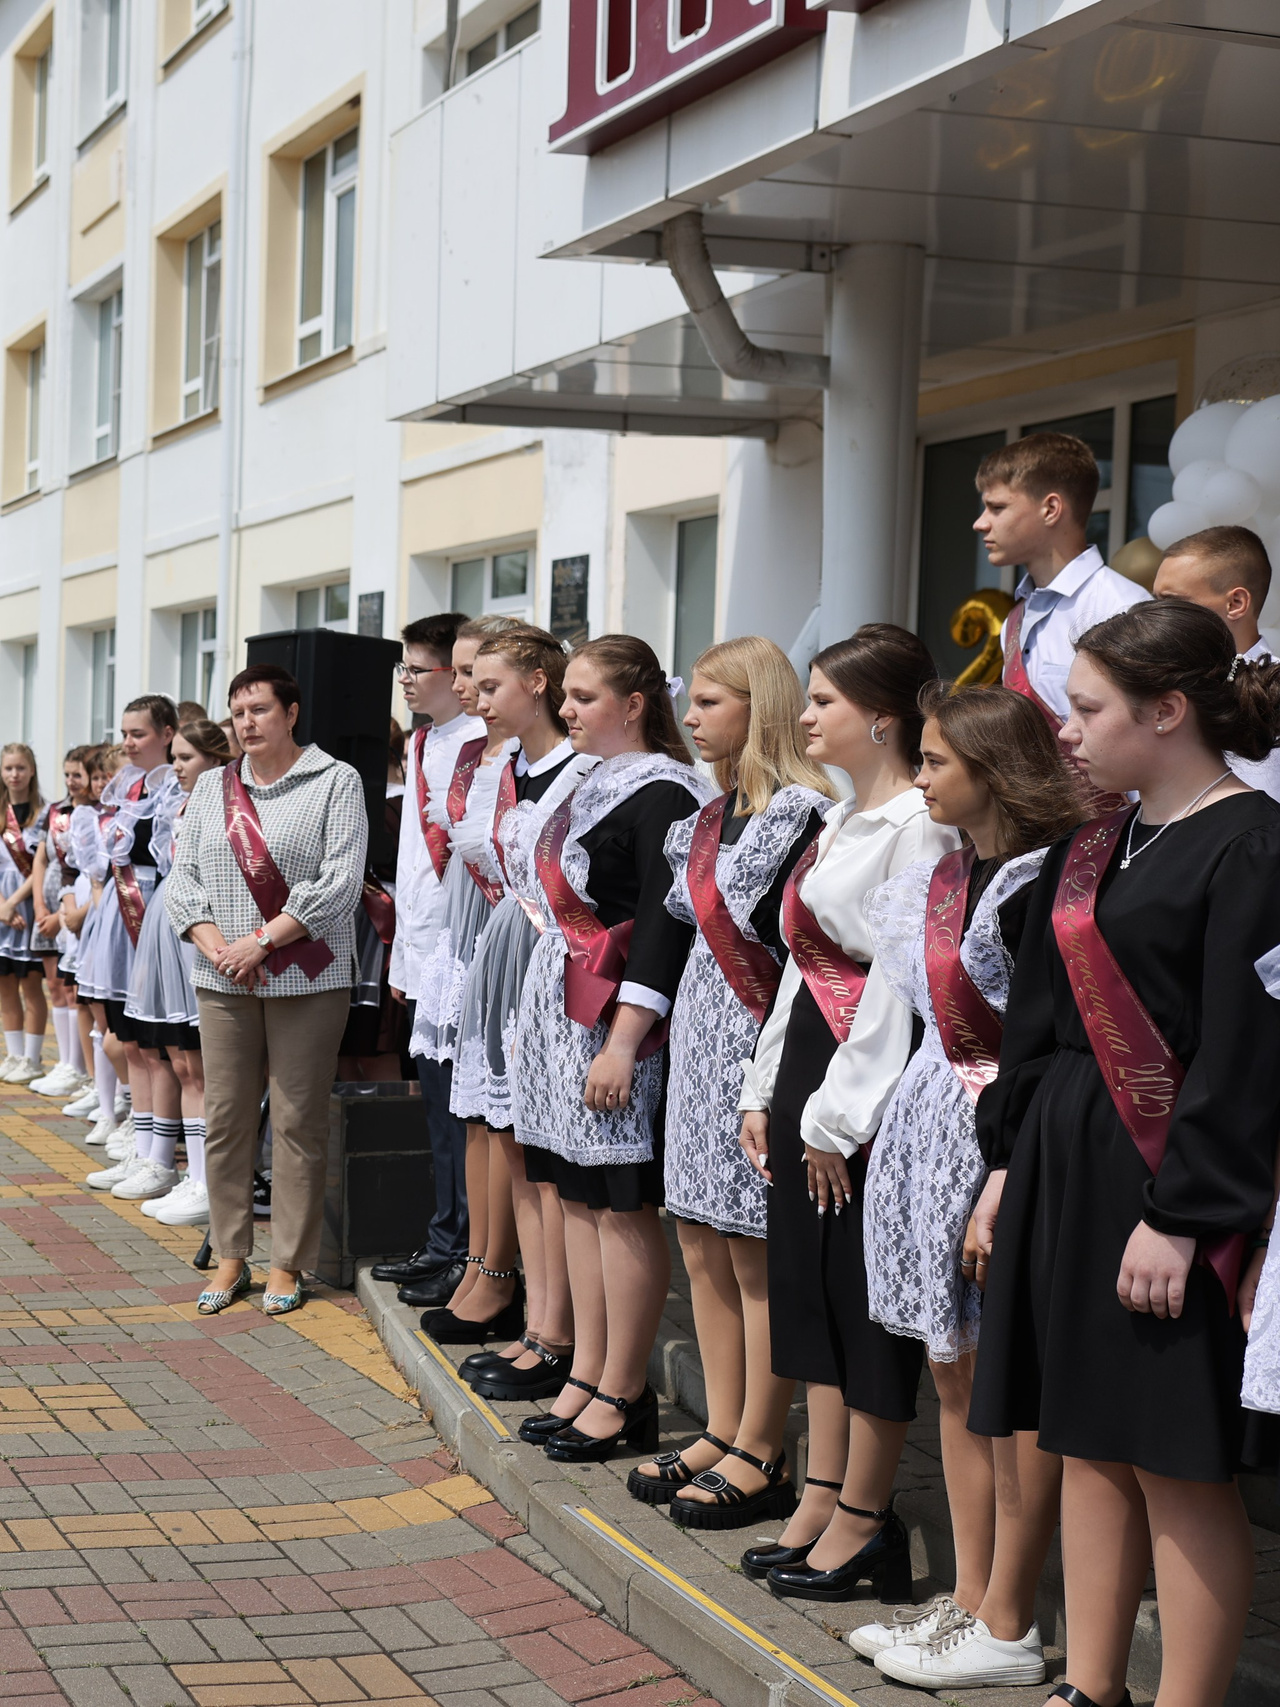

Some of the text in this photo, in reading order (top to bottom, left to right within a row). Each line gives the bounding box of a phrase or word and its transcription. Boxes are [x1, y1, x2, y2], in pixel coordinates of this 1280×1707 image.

[246, 856, 275, 885] 2025
[563, 907, 599, 943] 2025
[694, 831, 775, 1008] Выпусница 202
[786, 908, 861, 1028] ускница 20
[931, 926, 999, 1086] Выпускниц
[1064, 861, 1132, 1057] Выпускница
[1118, 1062, 1174, 1118] 2025
